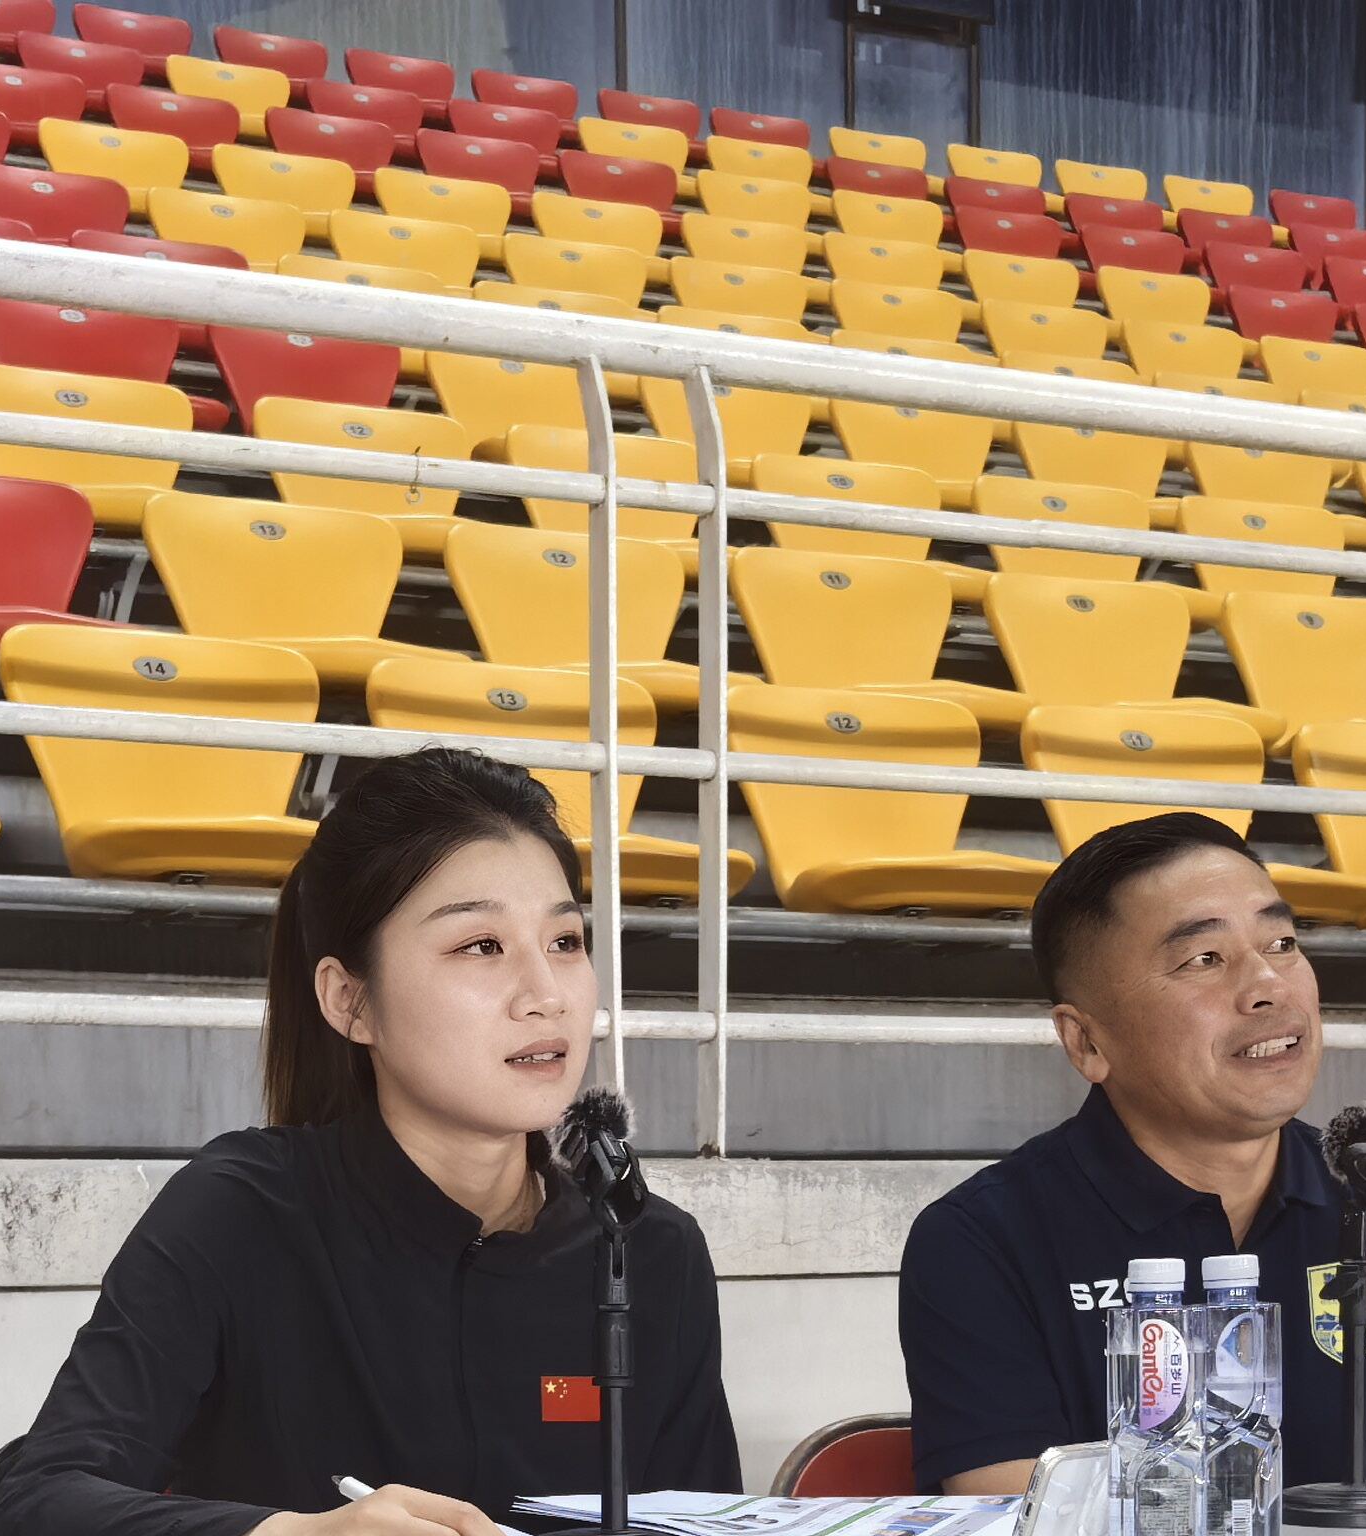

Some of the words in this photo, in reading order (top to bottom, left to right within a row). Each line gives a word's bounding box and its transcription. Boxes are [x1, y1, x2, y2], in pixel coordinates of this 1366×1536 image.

[63, 392, 81, 404] 13
[258, 525, 277, 537] 13
[551, 552, 568, 564] 12
[143, 661, 166, 675] 14
[496, 692, 517, 706] 13
[834, 716, 854, 730] 12
